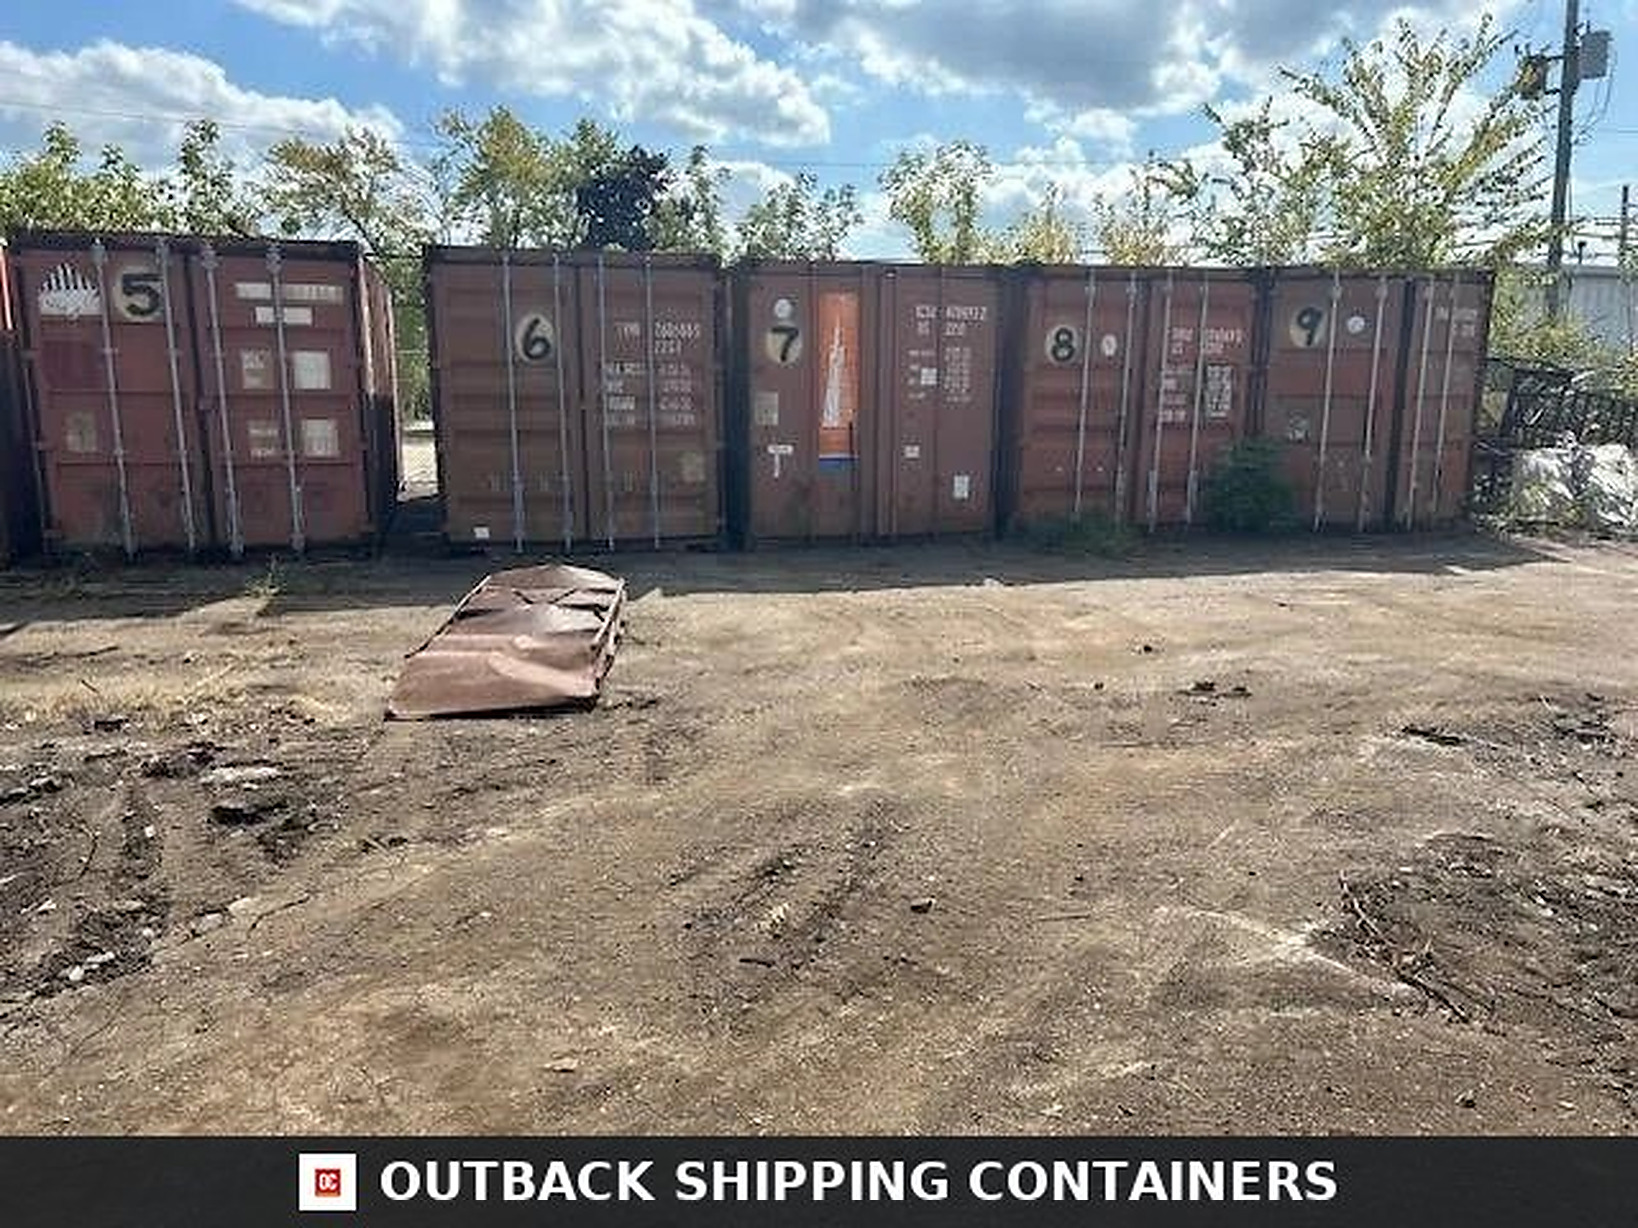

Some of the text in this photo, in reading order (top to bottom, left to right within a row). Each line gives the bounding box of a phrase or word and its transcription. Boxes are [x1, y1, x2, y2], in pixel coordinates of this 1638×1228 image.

[121, 271, 164, 316] 5
[522, 317, 551, 360] 6
[770, 326, 800, 362] 7
[1051, 326, 1076, 362] 8
[1297, 306, 1322, 346] 9
